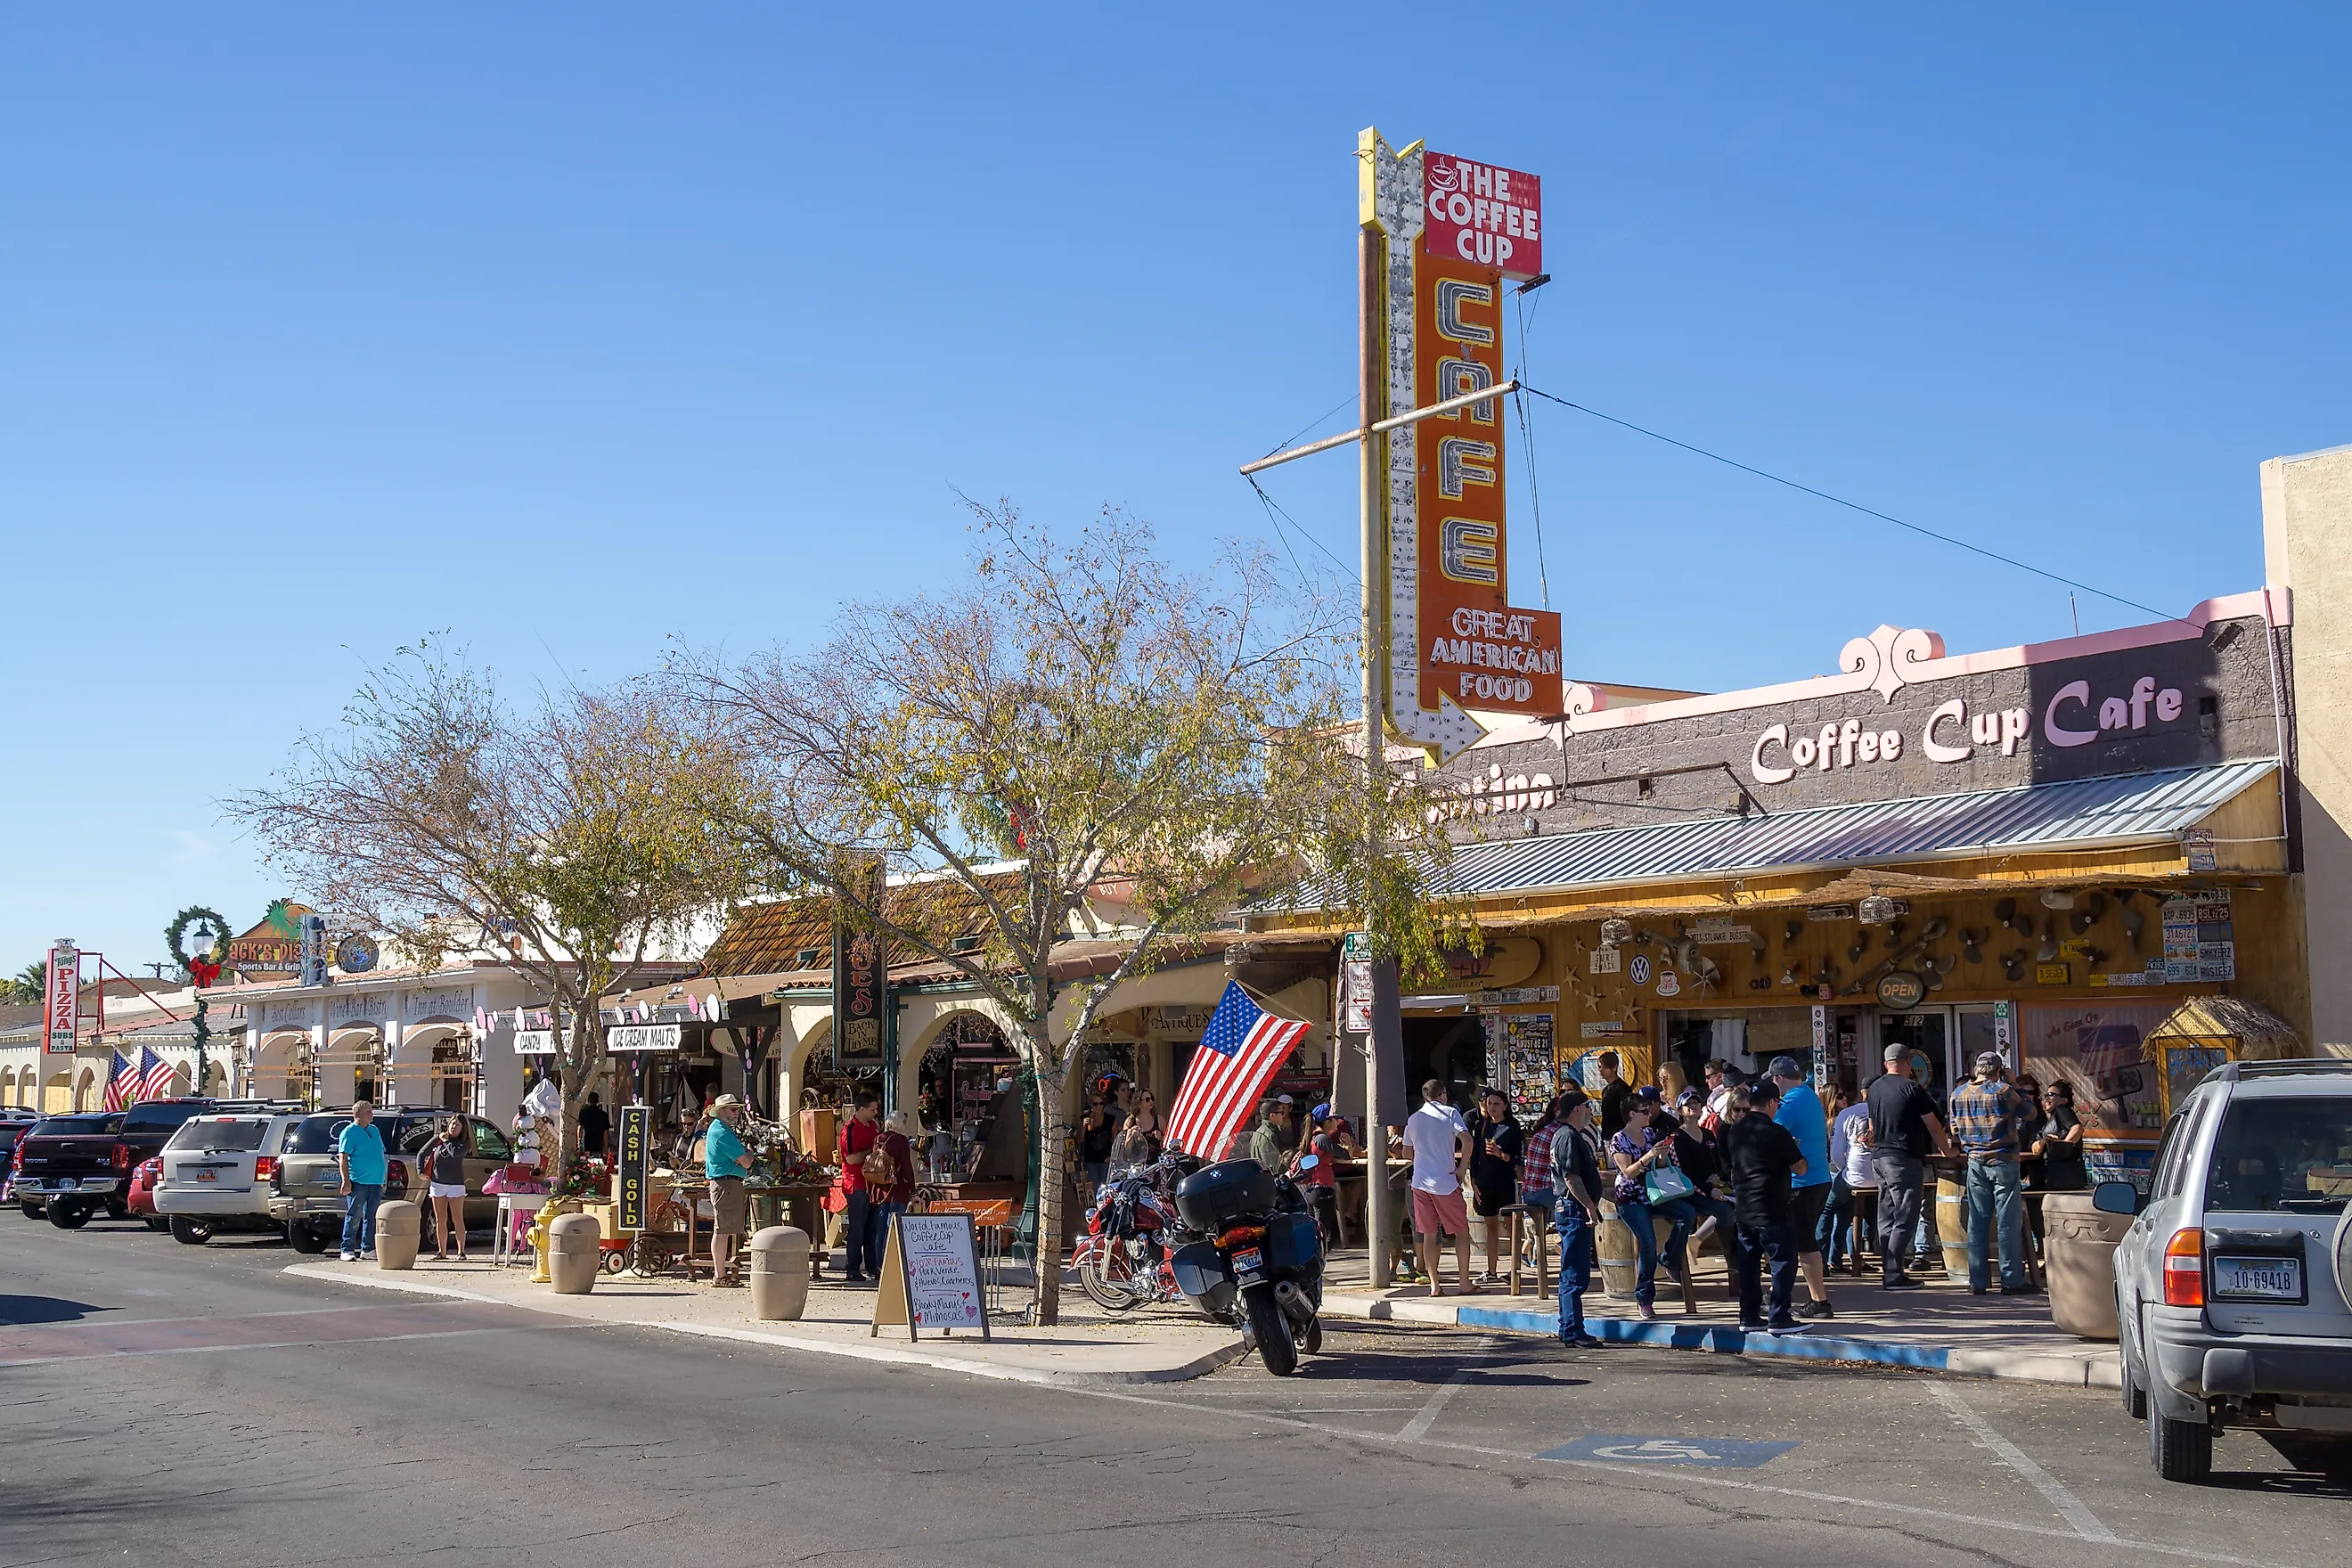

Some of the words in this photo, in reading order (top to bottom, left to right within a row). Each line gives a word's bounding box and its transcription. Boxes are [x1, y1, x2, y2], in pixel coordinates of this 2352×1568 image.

[1456, 161, 1511, 201] THE
[1428, 190, 1539, 241] COFFEE
[1457, 229, 1513, 266] CUP
[1434, 277, 1499, 587] CAFE
[1452, 608, 1534, 643] GREAT
[1430, 636, 1560, 675] AMERICAN
[1460, 672, 1533, 703] FOOD
[1751, 719, 1904, 785] Coffee
[1923, 698, 2031, 764] Cup
[2044, 676, 2184, 747] Cafe
[1098, 883, 1118, 895] BUY
[54, 955, 77, 968] Tony's
[237, 962, 262, 972] Sports
[263, 962, 278, 971] Bar
[278, 962, 283, 971] &
[284, 962, 300, 971] Grill
[1352, 974, 1371, 982] OVERS
[1354, 983, 1370, 991] VEHIC
[1882, 984, 1916, 997] OPEN
[53, 968, 74, 1030] PIZZA
[438, 990, 469, 1014] Boulder
[848, 1020, 875, 1035] BACK
[1905, 1016, 1923, 1026] 512
[52, 1032, 74, 1040] SUBS
[519, 1033, 541, 1051] CANDY
[613, 1027, 624, 1048] ICE
[625, 1026, 648, 1048] CREAM
[650, 1026, 676, 1047] MALTS
[857, 1031, 867, 1039] IN
[847, 1037, 877, 1051] THYME
[627, 1112, 640, 1162] CASH
[626, 1179, 638, 1225] GOLD
[904, 1220, 930, 1231] World
[911, 1230, 939, 1242] Coffee
[940, 1230, 953, 1243] Cup
[923, 1241, 947, 1251] Cafe
[936, 1266, 961, 1276] Verde
